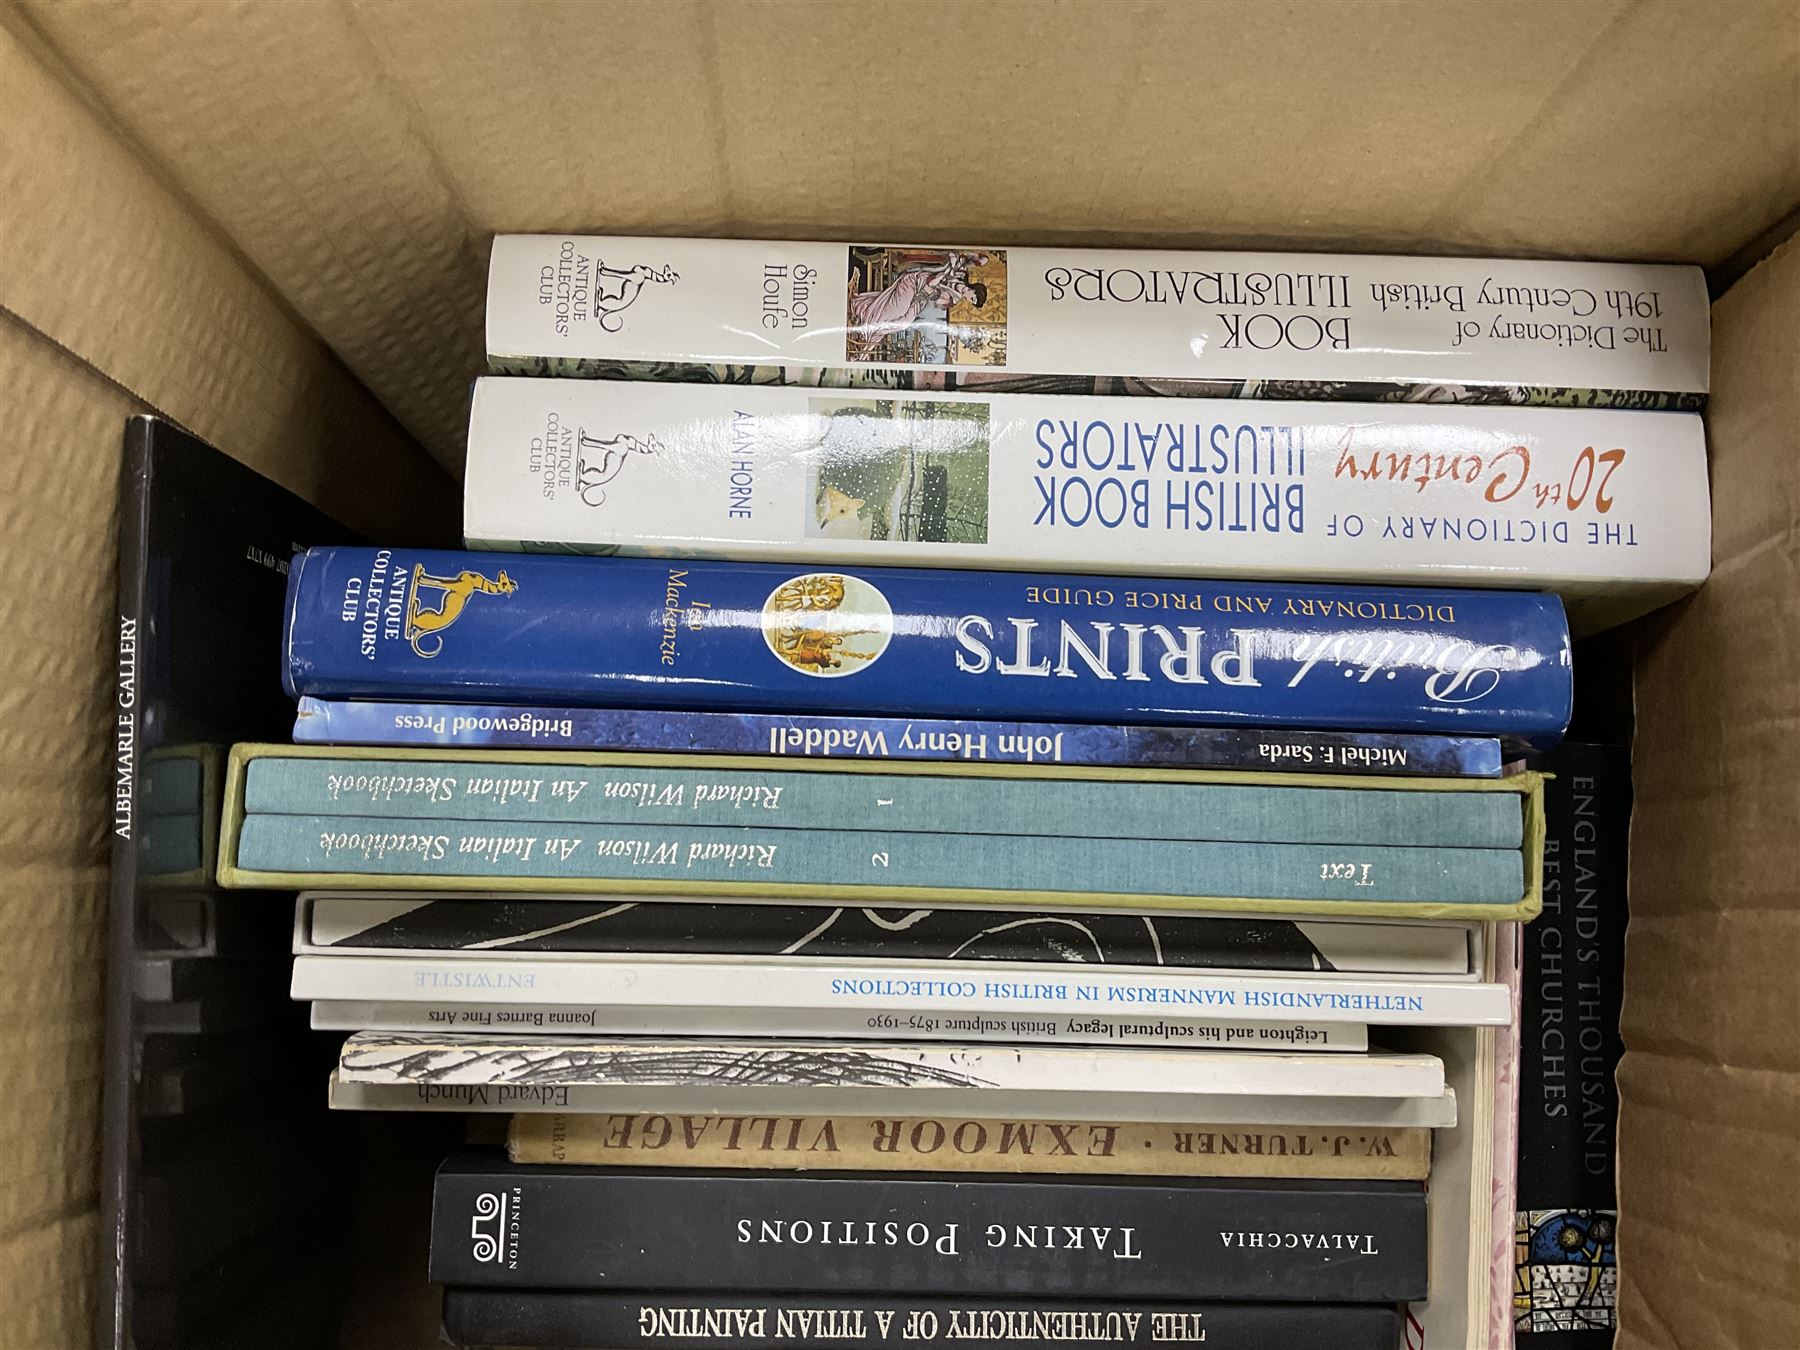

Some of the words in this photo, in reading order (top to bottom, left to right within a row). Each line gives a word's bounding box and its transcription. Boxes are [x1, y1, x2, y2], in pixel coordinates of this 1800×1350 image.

[538, 265, 554, 305] CLUB
[573, 254, 589, 322] ANTIQUE
[761, 263, 788, 329] Houfe
[790, 263, 817, 330] Simon
[1044, 267, 1350, 305] ILLUSTRATORS
[1369, 282, 1464, 311] British
[1476, 279, 1597, 315] Century
[1604, 289, 1662, 317] 19th
[1217, 313, 1351, 350] BOOK
[1452, 321, 1480, 346] of
[1488, 314, 1614, 349] Dictionary
[1623, 326, 1667, 351] The
[734, 409, 755, 458] ALAN
[528, 438, 543, 473] CLUB
[558, 426, 573, 488] ANTIQUE
[1034, 419, 1306, 475] ILLUSTRATORS
[1333, 428, 1531, 503] Century
[728, 462, 753, 519] HORNE
[1532, 446, 1627, 514] 20th
[1032, 476, 1151, 528] BOOK
[1164, 480, 1305, 532] BRITISH
[1326, 514, 1363, 538] OF
[1381, 516, 1568, 544] DICTIONARY
[1586, 522, 1638, 546] THE
[340, 576, 362, 622] CLUB
[383, 565, 410, 640] ANTIQUE
[1025, 586, 1114, 607] GUIDE
[1125, 592, 1202, 612] PRICE
[1212, 595, 1272, 615] AND
[661, 568, 689, 665] Mackenzie
[688, 599, 712, 631] Ian
[1284, 598, 1455, 623] DICTIONARY
[119, 615, 137, 708] GALLERY
[953, 614, 1262, 687] PRINTS
[1287, 634, 1516, 704] British
[394, 715, 447, 732] Press
[451, 714, 573, 737] Bridgewood
[769, 727, 889, 756] Waddell
[899, 725, 987, 758] Henry
[998, 733, 1064, 760] John
[1258, 743, 1313, 763] Sarda
[1318, 746, 1333, 763] F.
[1339, 747, 1407, 766] Michel
[115, 713, 135, 840] ALBEMARLE
[326, 774, 456, 800] Sketchbook
[465, 778, 543, 802] Italian
[550, 779, 587, 803] An
[604, 782, 684, 806] Wilson
[694, 784, 783, 809] Richard
[318, 832, 450, 859] Sketchbook
[460, 837, 536, 860] Italian
[544, 838, 581, 861] An
[597, 840, 679, 865] Wilson
[690, 842, 778, 868] Richard
[872, 852, 889, 867] 2
[1573, 776, 1600, 963] ENGLAND'S
[1320, 862, 1374, 886] Text
[413, 972, 536, 989] ENTWISTLE
[828, 978, 976, 998] COLLECTIONS
[984, 983, 1068, 1000] BRITISH
[1076, 986, 1099, 1002] IN
[1108, 986, 1236, 1005] MANNERISM
[1244, 991, 1424, 1012] NETHERLANDISH
[429, 1011, 457, 1026] Arts
[462, 1012, 492, 1027] Fine
[497, 1012, 544, 1027] Barnes
[549, 1010, 597, 1028] Joanna
[945, 1017, 1006, 1034] sculpture
[1010, 1020, 1057, 1037] British
[1066, 1018, 1114, 1037] legacy
[1118, 1021, 1194, 1040] sculptural
[1539, 926, 1568, 1118] CHURCHES
[1198, 1026, 1221, 1041] his
[1226, 1027, 1254, 1042] and
[1260, 1025, 1328, 1044] Leighton
[1576, 977, 1608, 1177] THOUSAND
[418, 1083, 490, 1105] Munch
[498, 1085, 569, 1107] Edvard
[601, 1112, 841, 1152] VILLAGE
[870, 1118, 1121, 1158] EXMOOR
[1173, 1132, 1313, 1156] TURNER
[1321, 1136, 1351, 1157] J.
[1360, 1137, 1397, 1158] W.
[508, 1187, 521, 1270] PRINCETON
[639, 1307, 767, 1336] PAINTING
[775, 1309, 867, 1337] TITIAN
[874, 1310, 895, 1338] A
[902, 1311, 938, 1339] OF
[946, 1310, 1142, 1340] AUTHENTICITY
[1151, 1313, 1205, 1340] THE
